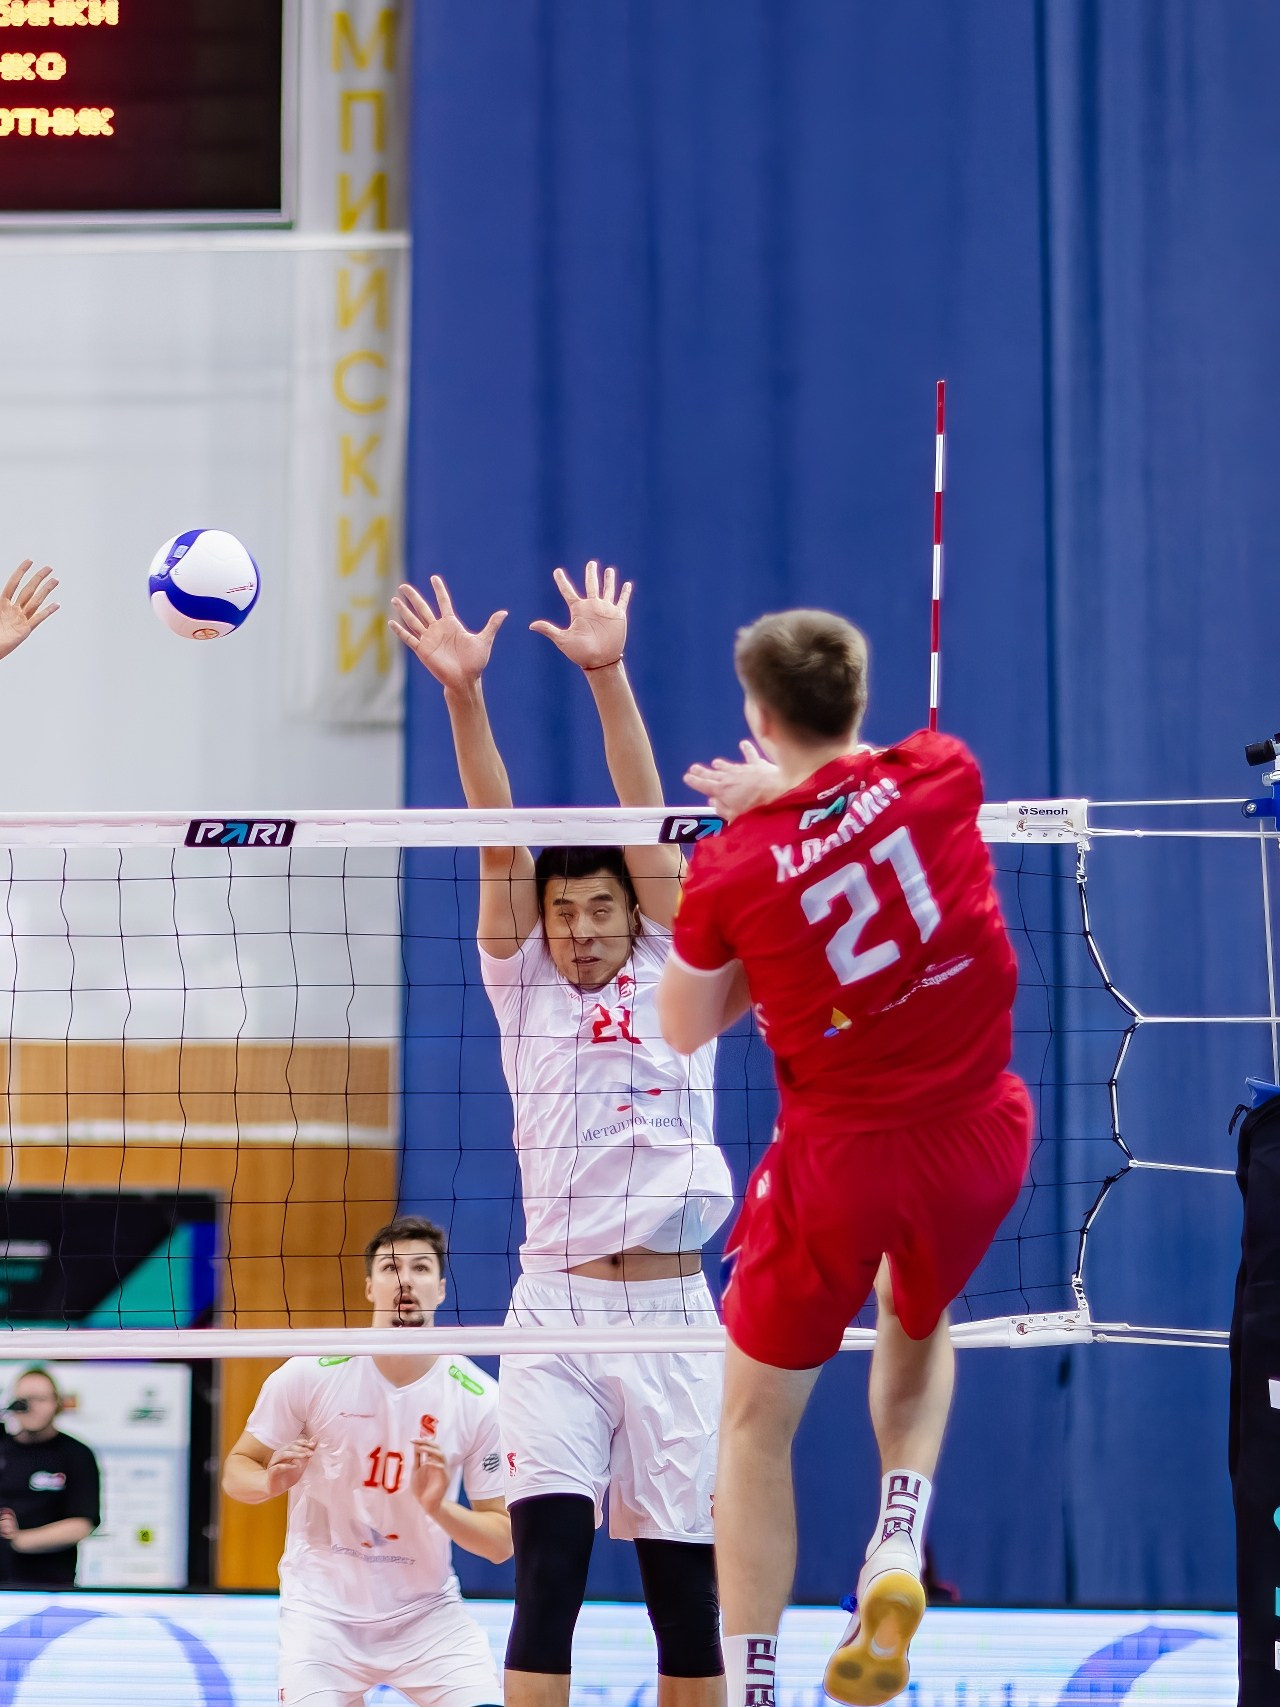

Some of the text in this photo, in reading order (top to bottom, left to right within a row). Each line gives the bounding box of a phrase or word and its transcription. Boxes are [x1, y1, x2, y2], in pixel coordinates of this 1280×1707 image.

[1029, 806, 1068, 816] Senoh
[194, 822, 287, 845] PARI
[363, 1446, 404, 1494] 10
